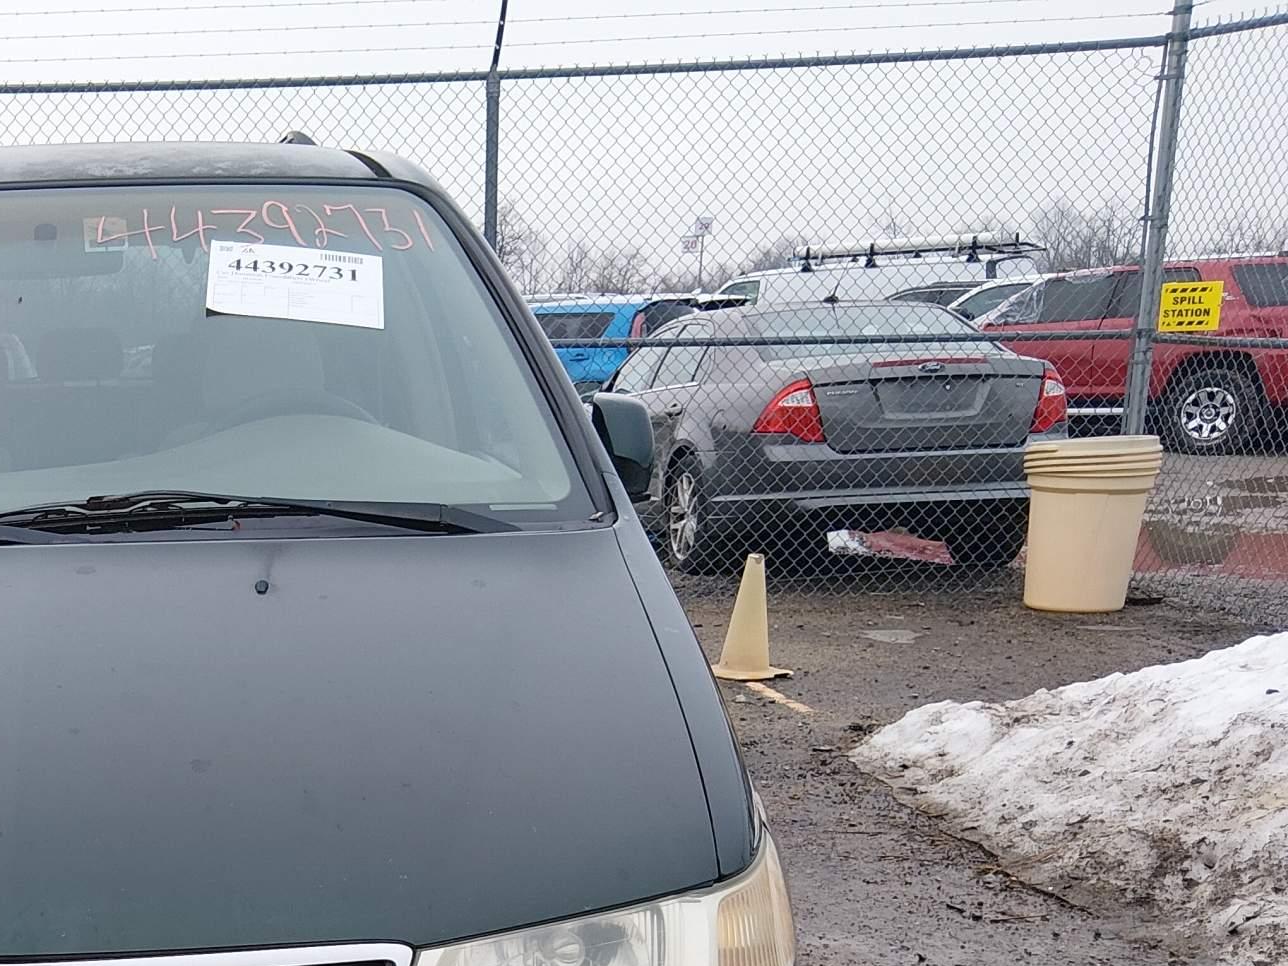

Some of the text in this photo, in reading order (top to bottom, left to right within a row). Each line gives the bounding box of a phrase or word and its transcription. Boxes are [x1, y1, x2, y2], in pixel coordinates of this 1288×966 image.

[96, 200, 435, 260] 44392731
[228, 258, 359, 282] 44392731
[1172, 296, 1204, 306] SPILL
[1163, 308, 1211, 318] STATION
